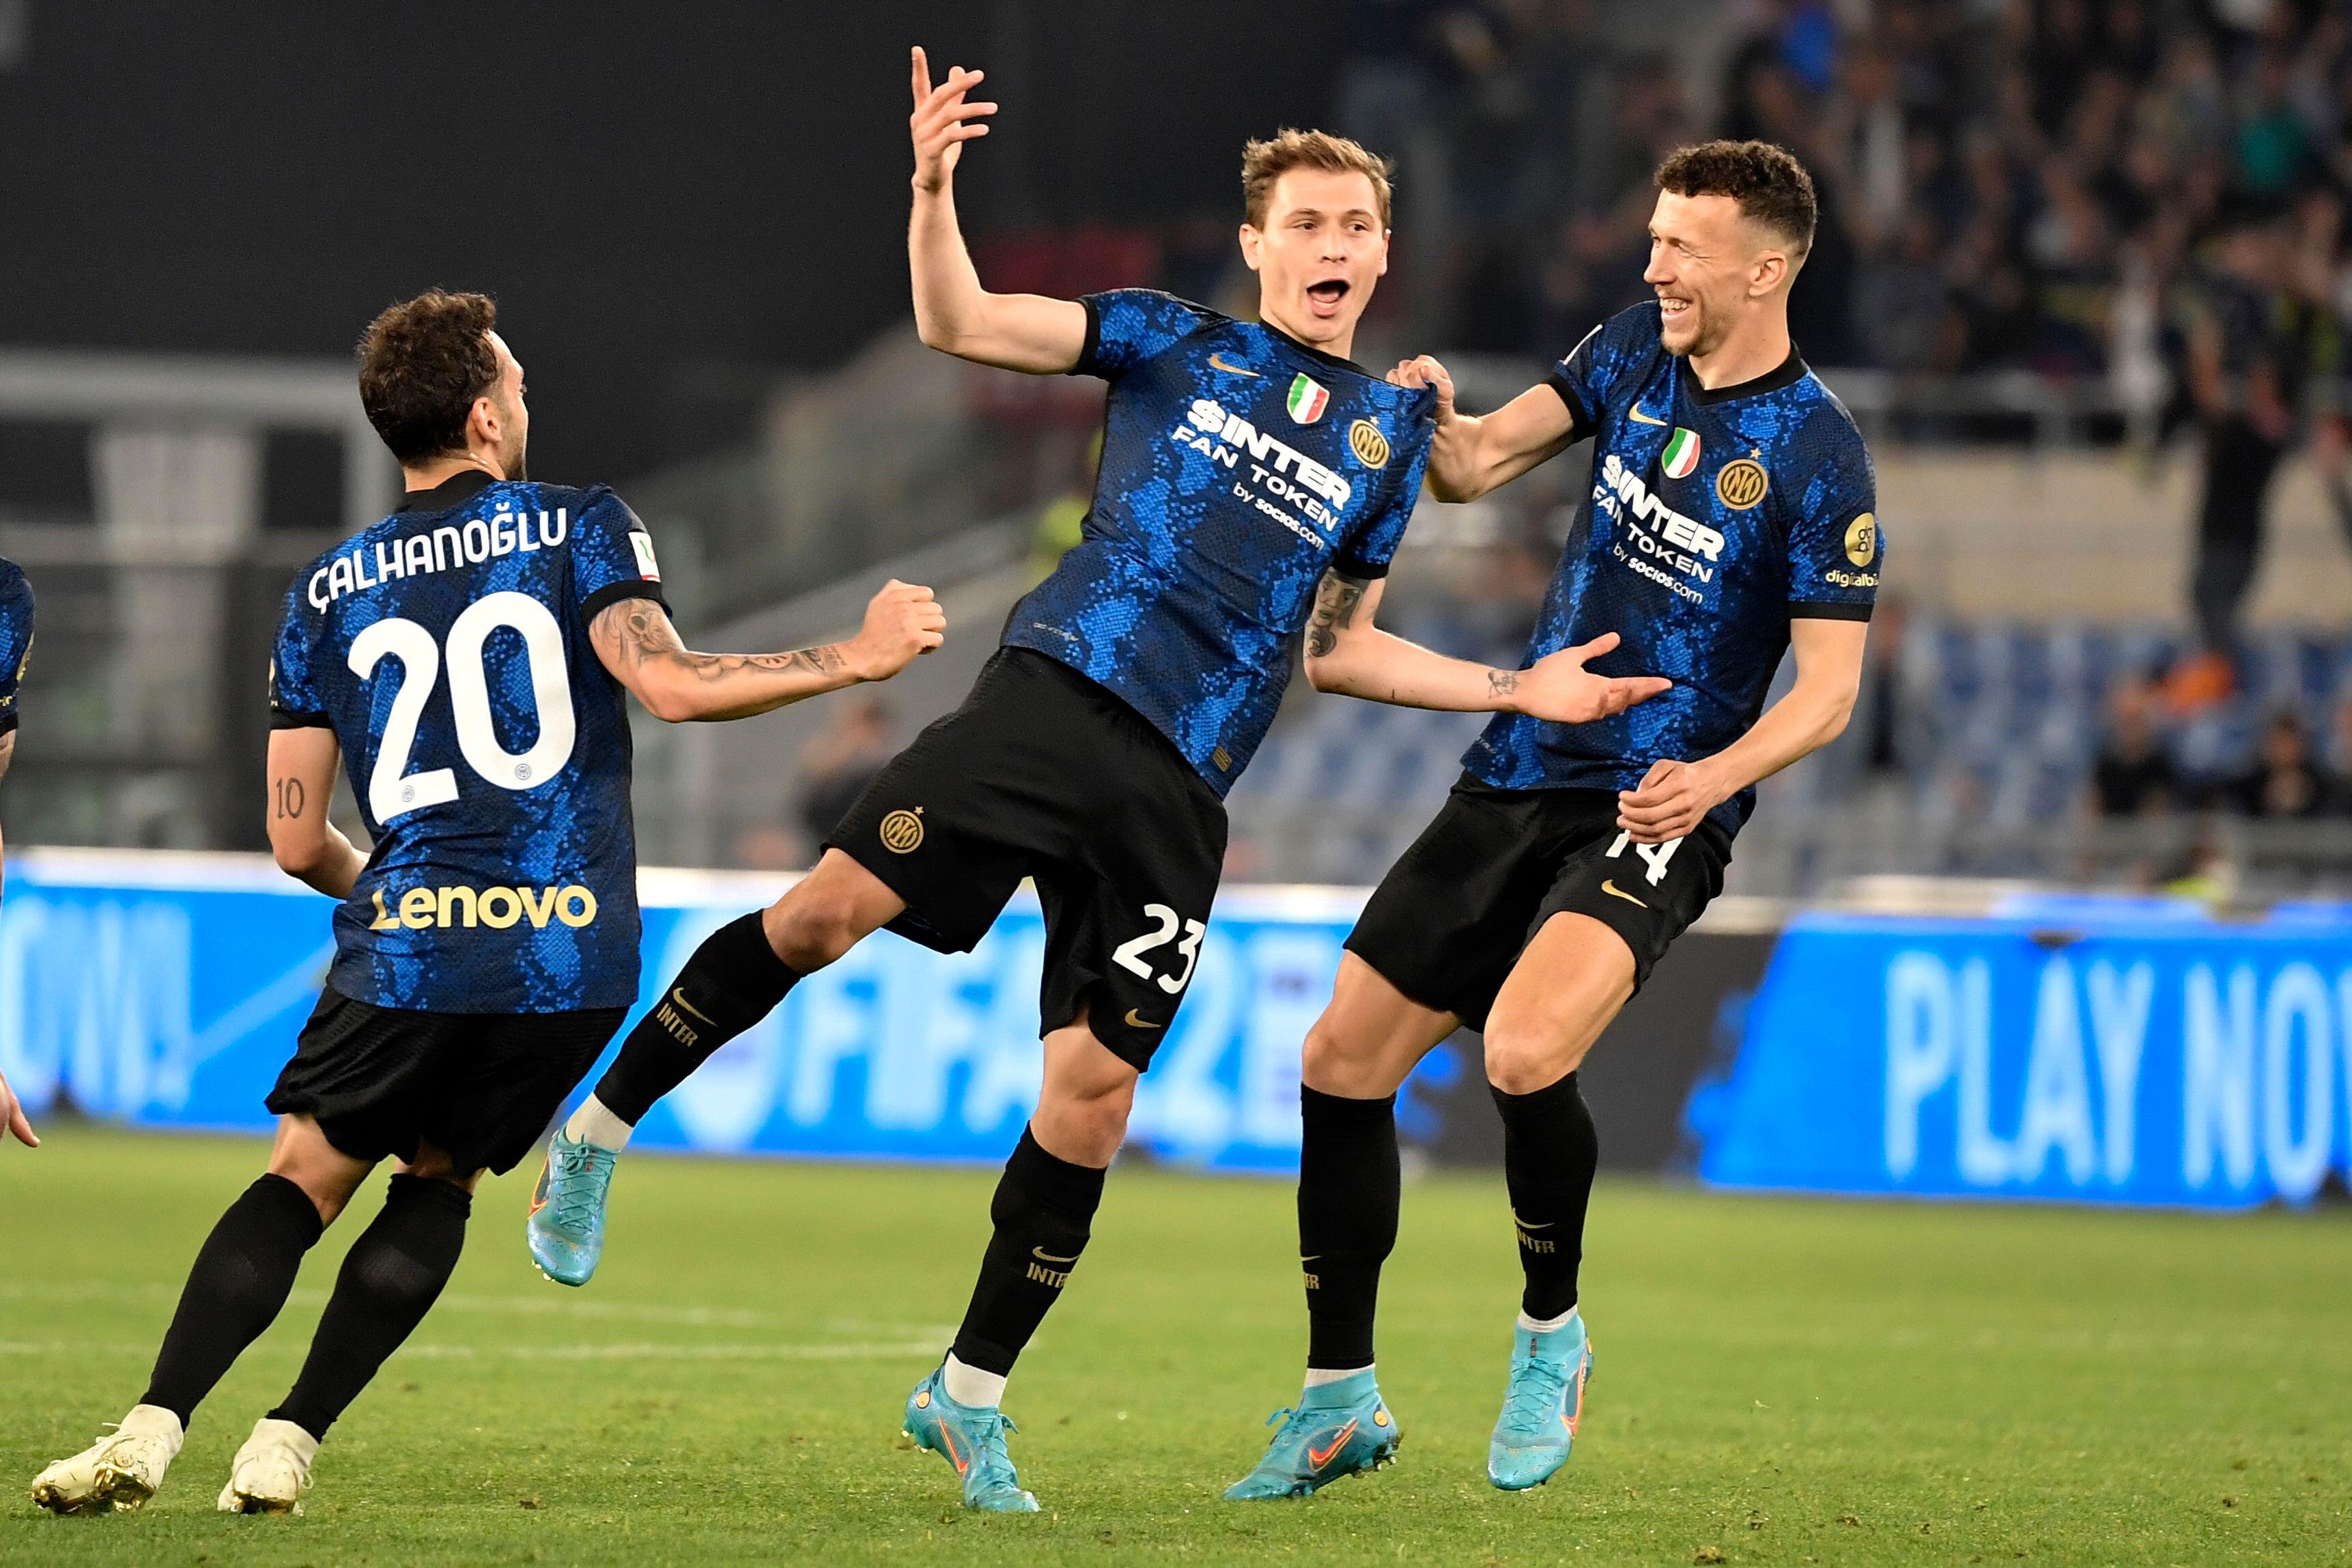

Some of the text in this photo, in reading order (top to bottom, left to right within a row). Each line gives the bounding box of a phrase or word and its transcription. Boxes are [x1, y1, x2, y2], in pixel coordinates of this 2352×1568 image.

[1172, 425, 1339, 532] FAN TOKEN
[1187, 399, 1351, 511] $INTER
[1233, 482, 1255, 502] by
[1592, 485, 1714, 583] FAN TOKEN
[1602, 455, 1725, 562] $INTER
[1613, 541, 1629, 562] by
[308, 502, 567, 614] ÇALHANOĞLU
[347, 591, 576, 827] 20
[276, 777, 305, 819] 10
[369, 885, 597, 930] Lenovo
[1111, 903, 1206, 995] 23
[657, 1002, 698, 1047] INTER
[1884, 953, 2352, 1207] PLAY NO
[1026, 1261, 1070, 1288] INTE
